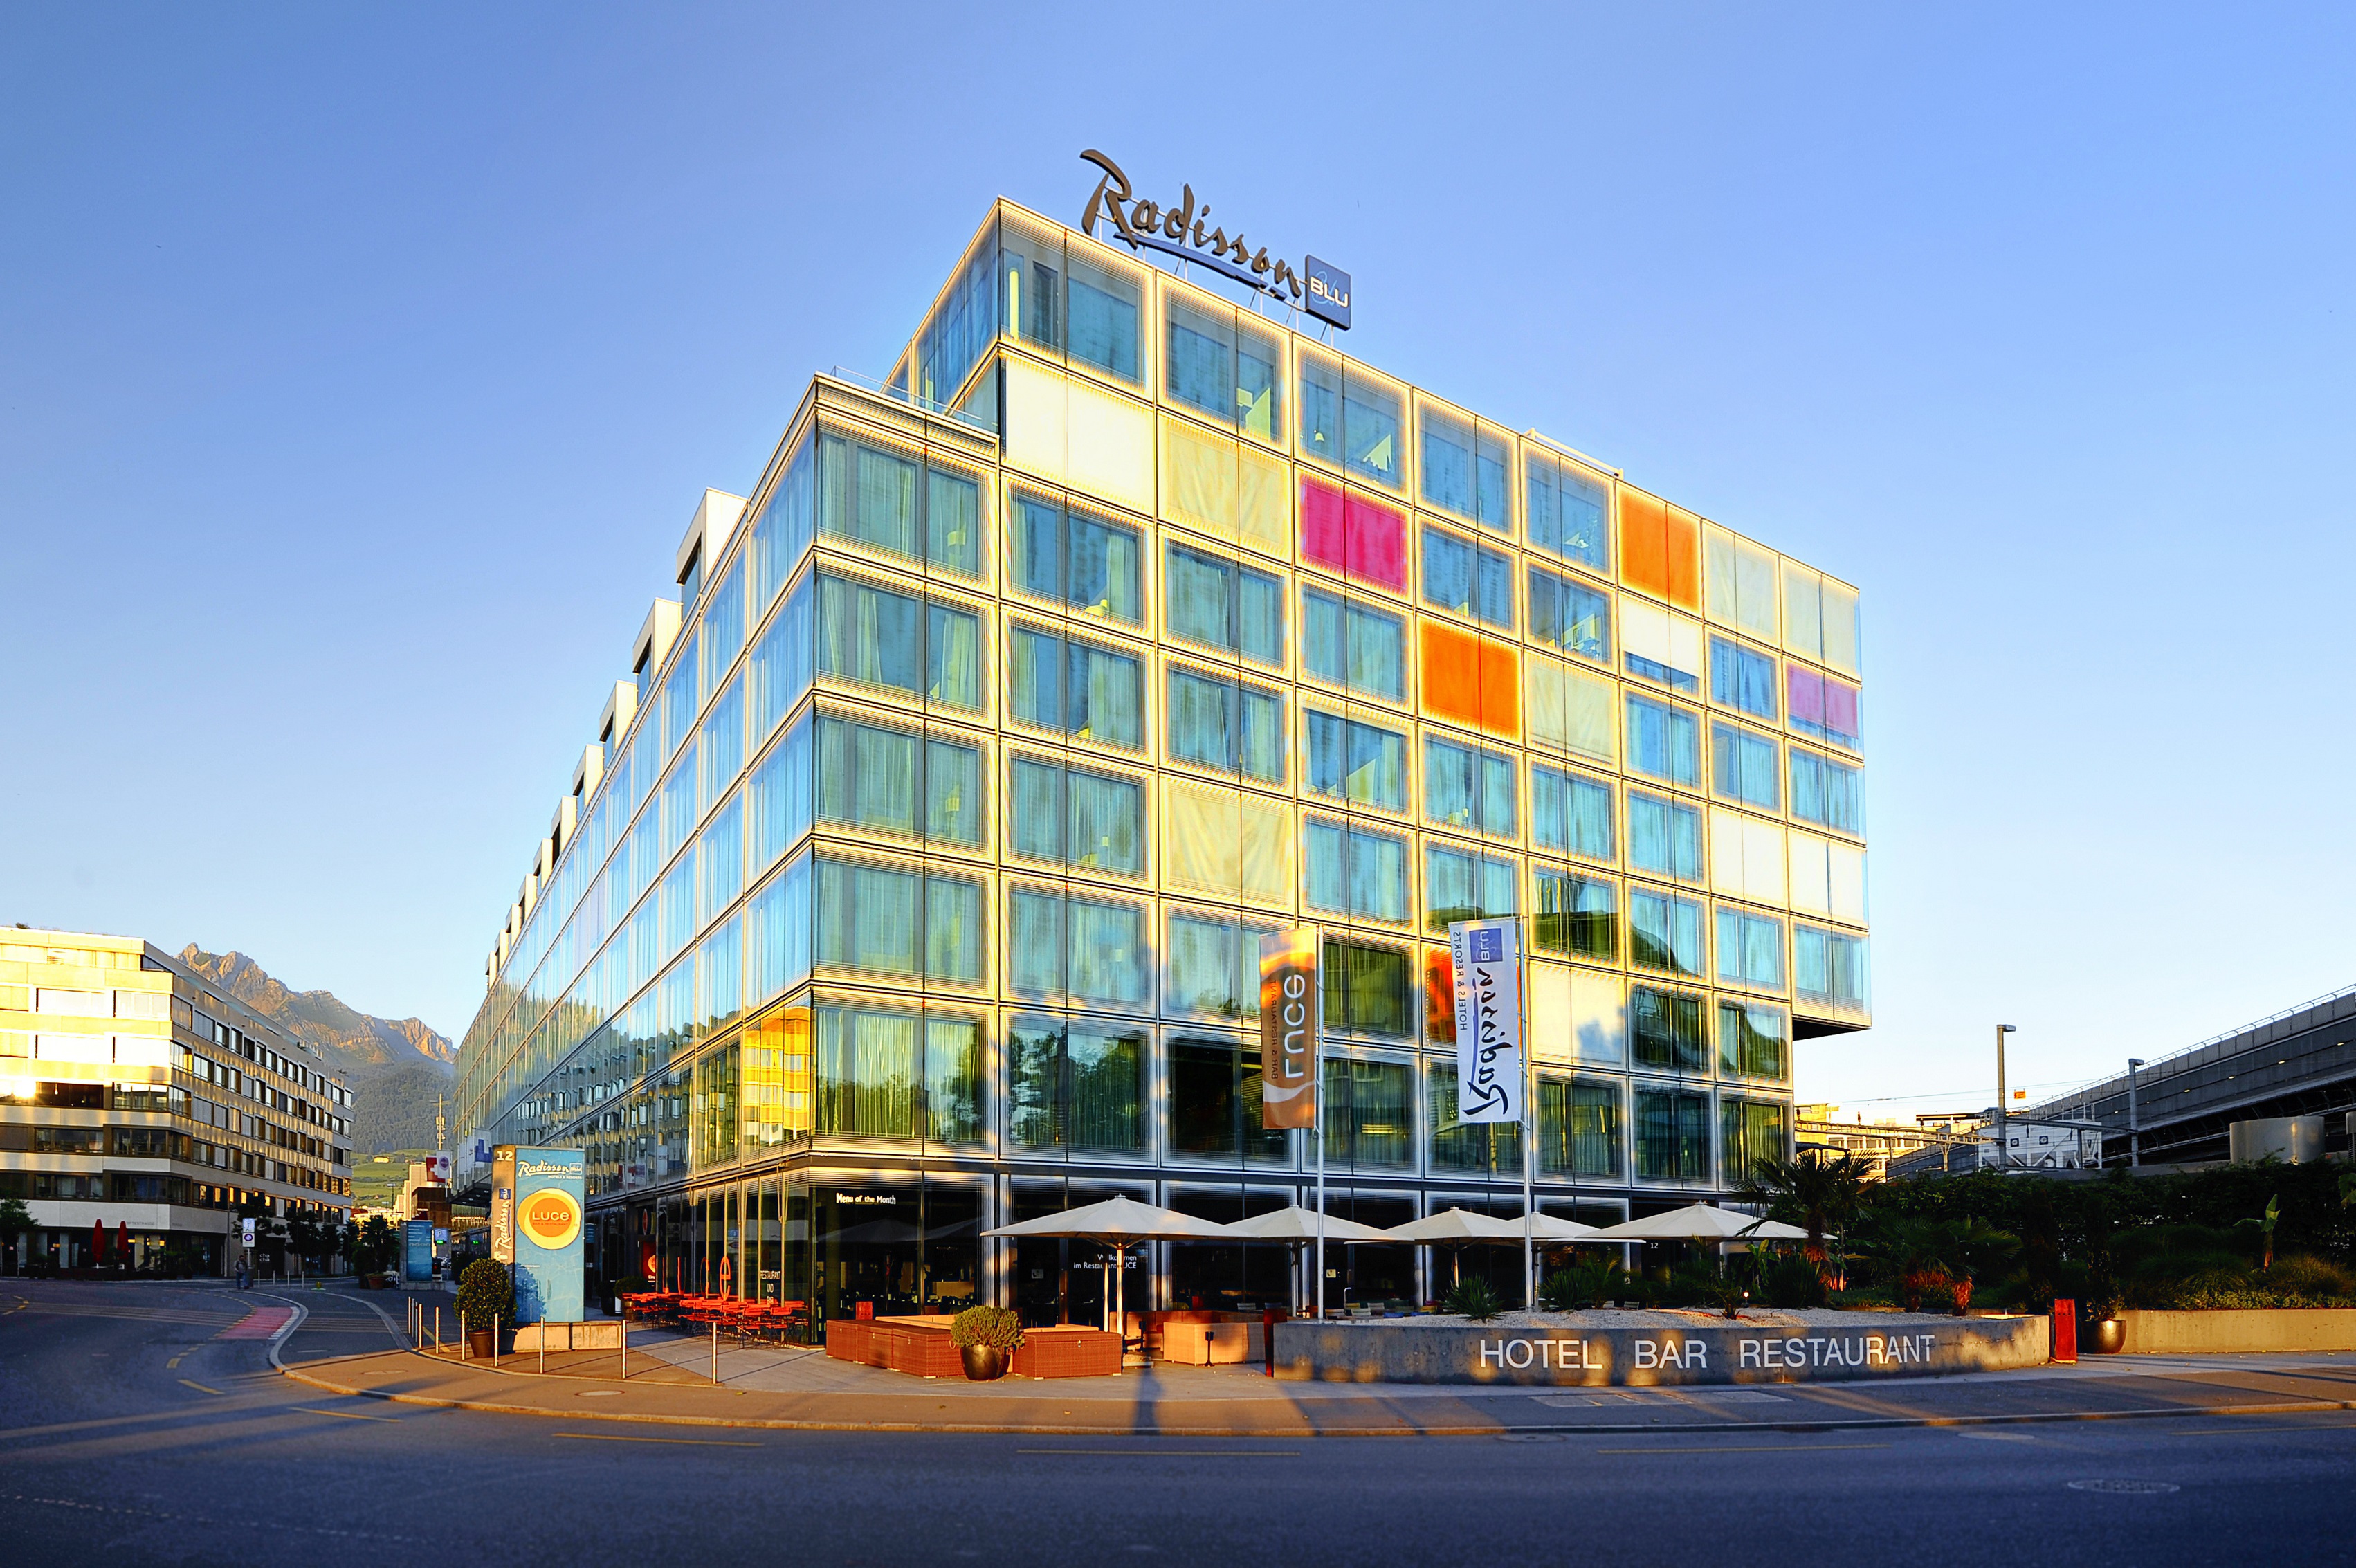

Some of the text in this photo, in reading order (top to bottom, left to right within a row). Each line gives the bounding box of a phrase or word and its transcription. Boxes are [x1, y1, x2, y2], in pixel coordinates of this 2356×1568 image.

[1080, 149, 1349, 308] Radisson BLU
[497, 1151, 513, 1161] 12
[518, 1159, 569, 1178] Radisson
[836, 1192, 854, 1204] Menu
[877, 1194, 896, 1205] Month
[495, 1201, 512, 1250] Radisson
[1479, 1334, 1935, 1370] HOTEL BAR RESTAURANT
